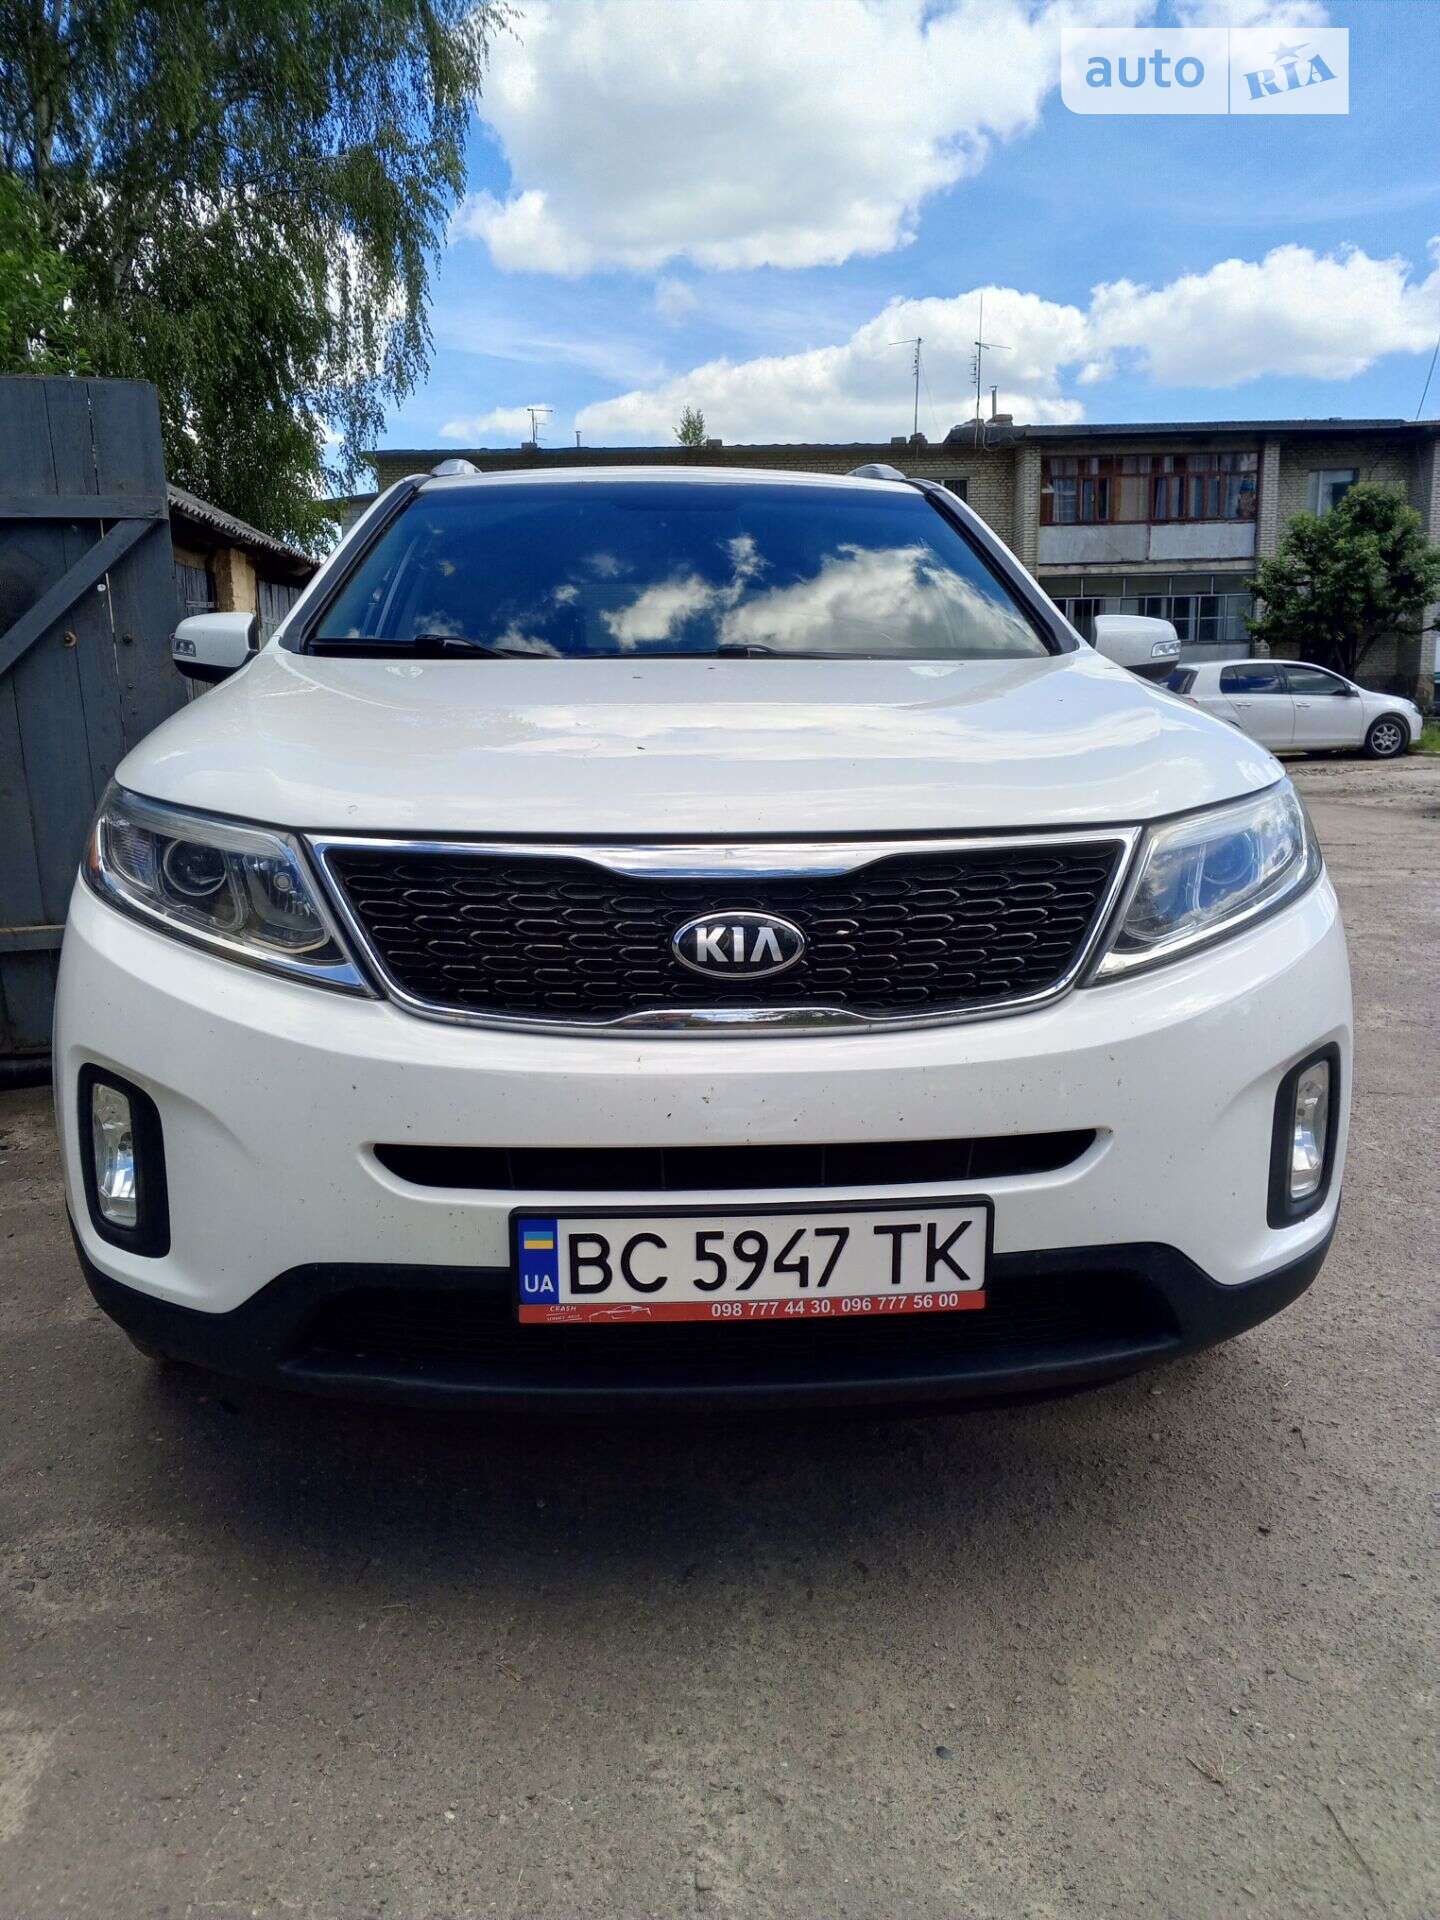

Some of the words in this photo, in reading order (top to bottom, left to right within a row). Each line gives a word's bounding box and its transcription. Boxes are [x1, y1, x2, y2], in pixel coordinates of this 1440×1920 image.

[695, 926, 784, 963] KIA
[568, 1232, 668, 1295] BC
[692, 1226, 851, 1291] 5947
[873, 1220, 973, 1285] TK
[524, 1274, 554, 1294] UA
[711, 1303, 742, 1317] 098
[749, 1301, 779, 1316] 777
[784, 1300, 805, 1314] 44
[811, 1299, 836, 1316] 30,
[841, 1297, 872, 1312] 096
[878, 1296, 907, 1310] 777
[913, 1295, 933, 1309] 56
[938, 1293, 959, 1308] 00
